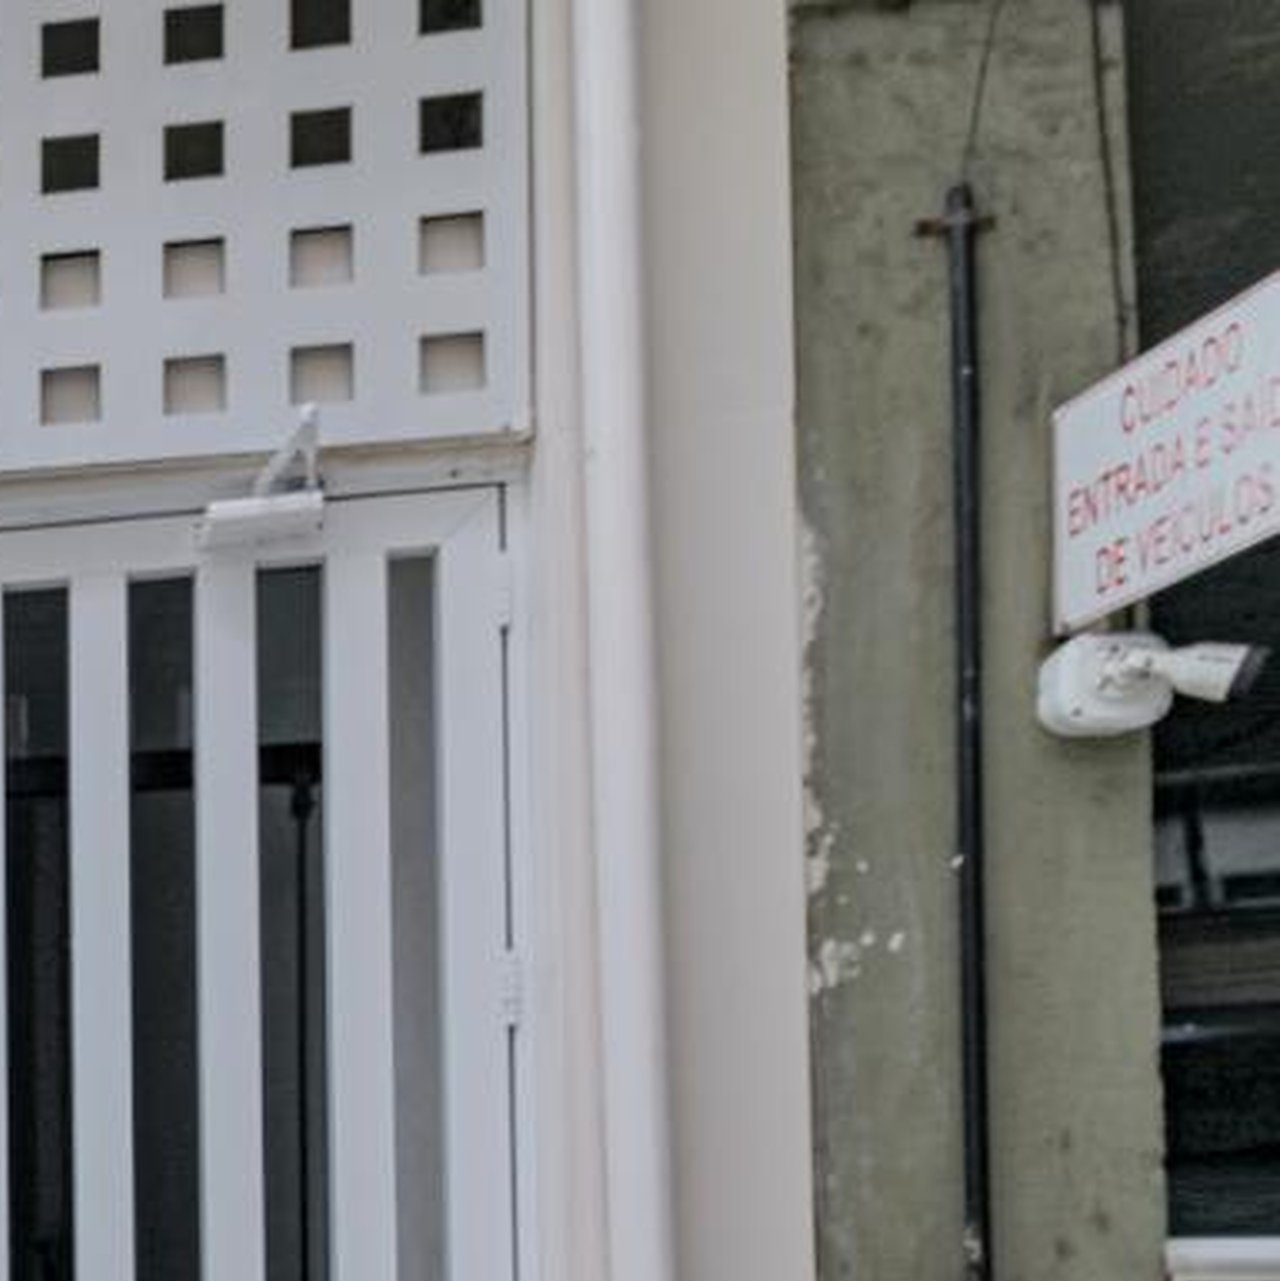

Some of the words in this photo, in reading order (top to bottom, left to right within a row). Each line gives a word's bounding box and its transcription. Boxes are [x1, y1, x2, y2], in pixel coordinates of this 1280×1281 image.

[1120, 321, 1242, 434] CUIDADO
[1068, 431, 1186, 538] ENTRADA
[1196, 415, 1210, 471] E
[1095, 535, 1127, 595] DE
